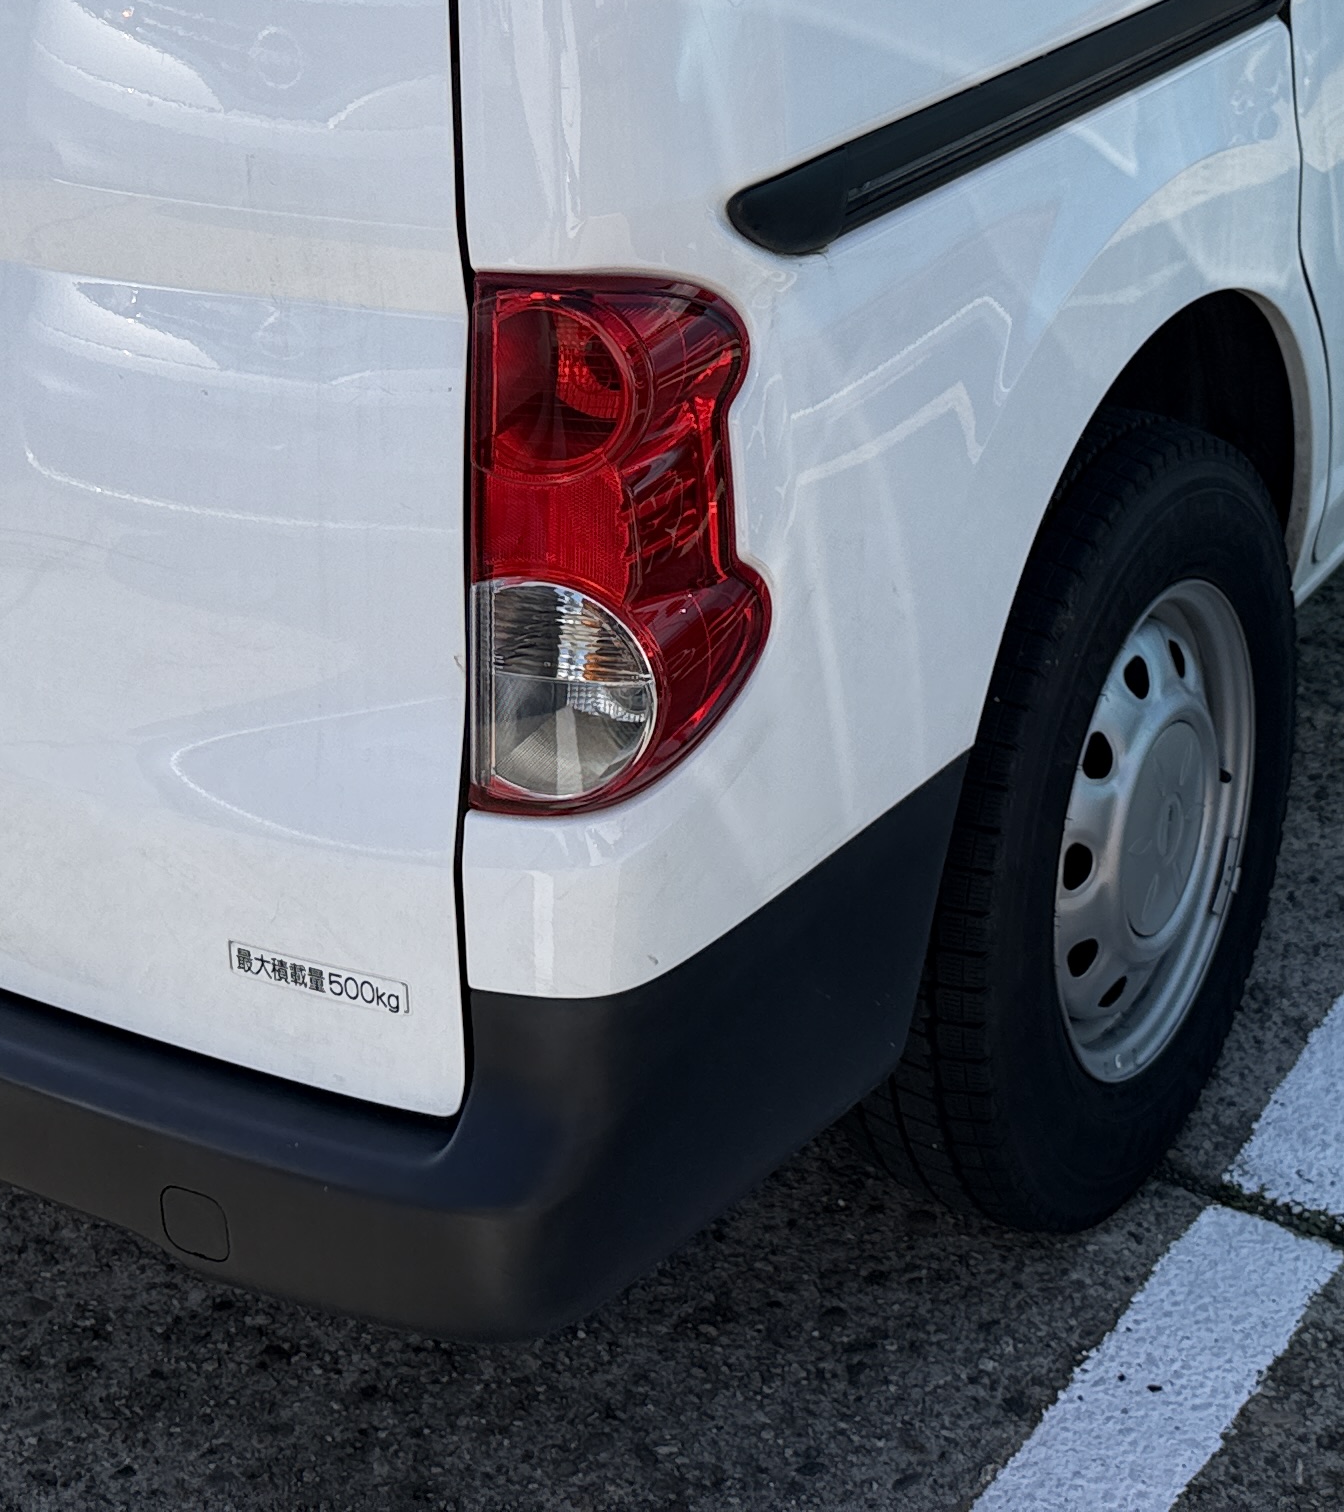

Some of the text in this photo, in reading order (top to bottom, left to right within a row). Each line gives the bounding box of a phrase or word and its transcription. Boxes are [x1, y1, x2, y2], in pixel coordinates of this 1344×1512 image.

[236, 947, 400, 1013] 最大積載量500kg
